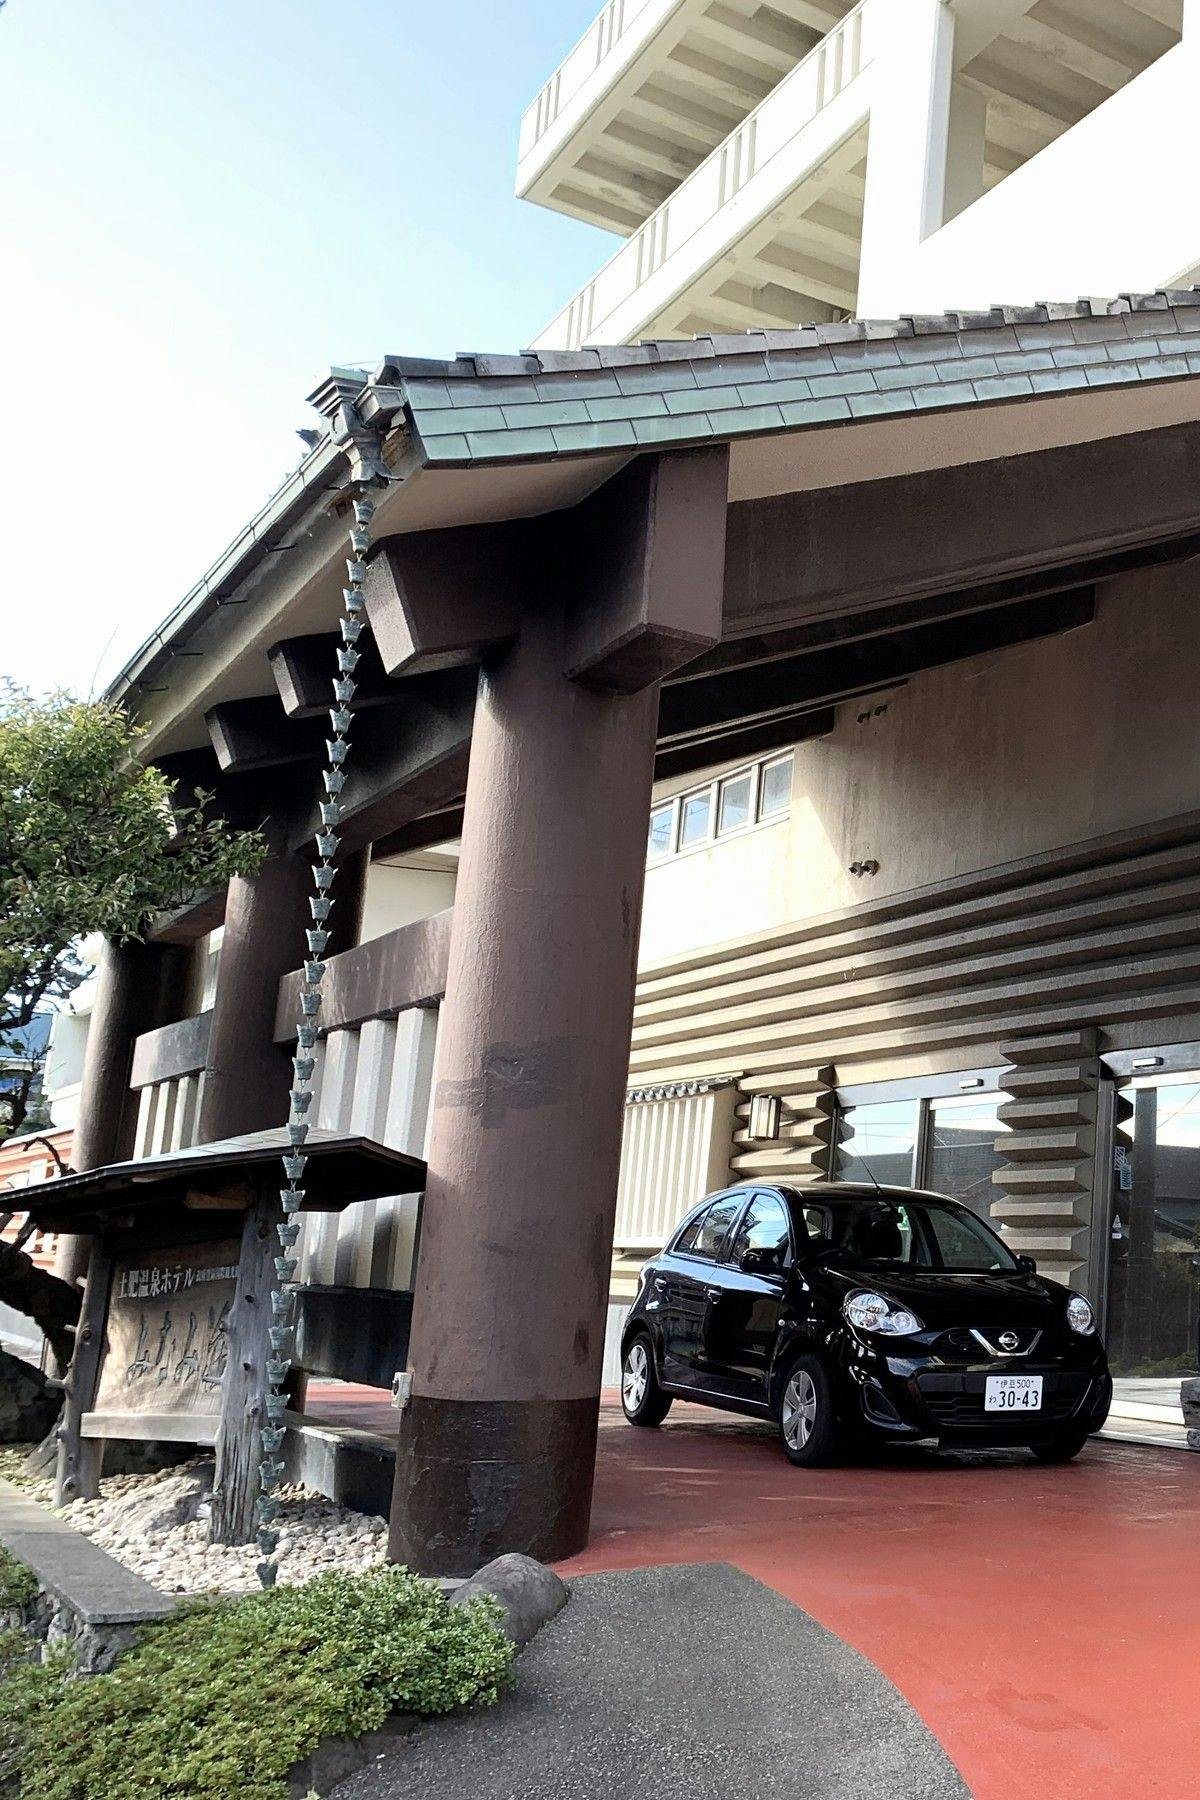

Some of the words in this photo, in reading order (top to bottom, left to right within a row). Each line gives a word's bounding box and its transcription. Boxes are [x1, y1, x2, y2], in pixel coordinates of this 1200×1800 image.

[117, 1265, 195, 1299] 土肥温泉ホテル
[998, 1390, 1039, 1408] 30-43
